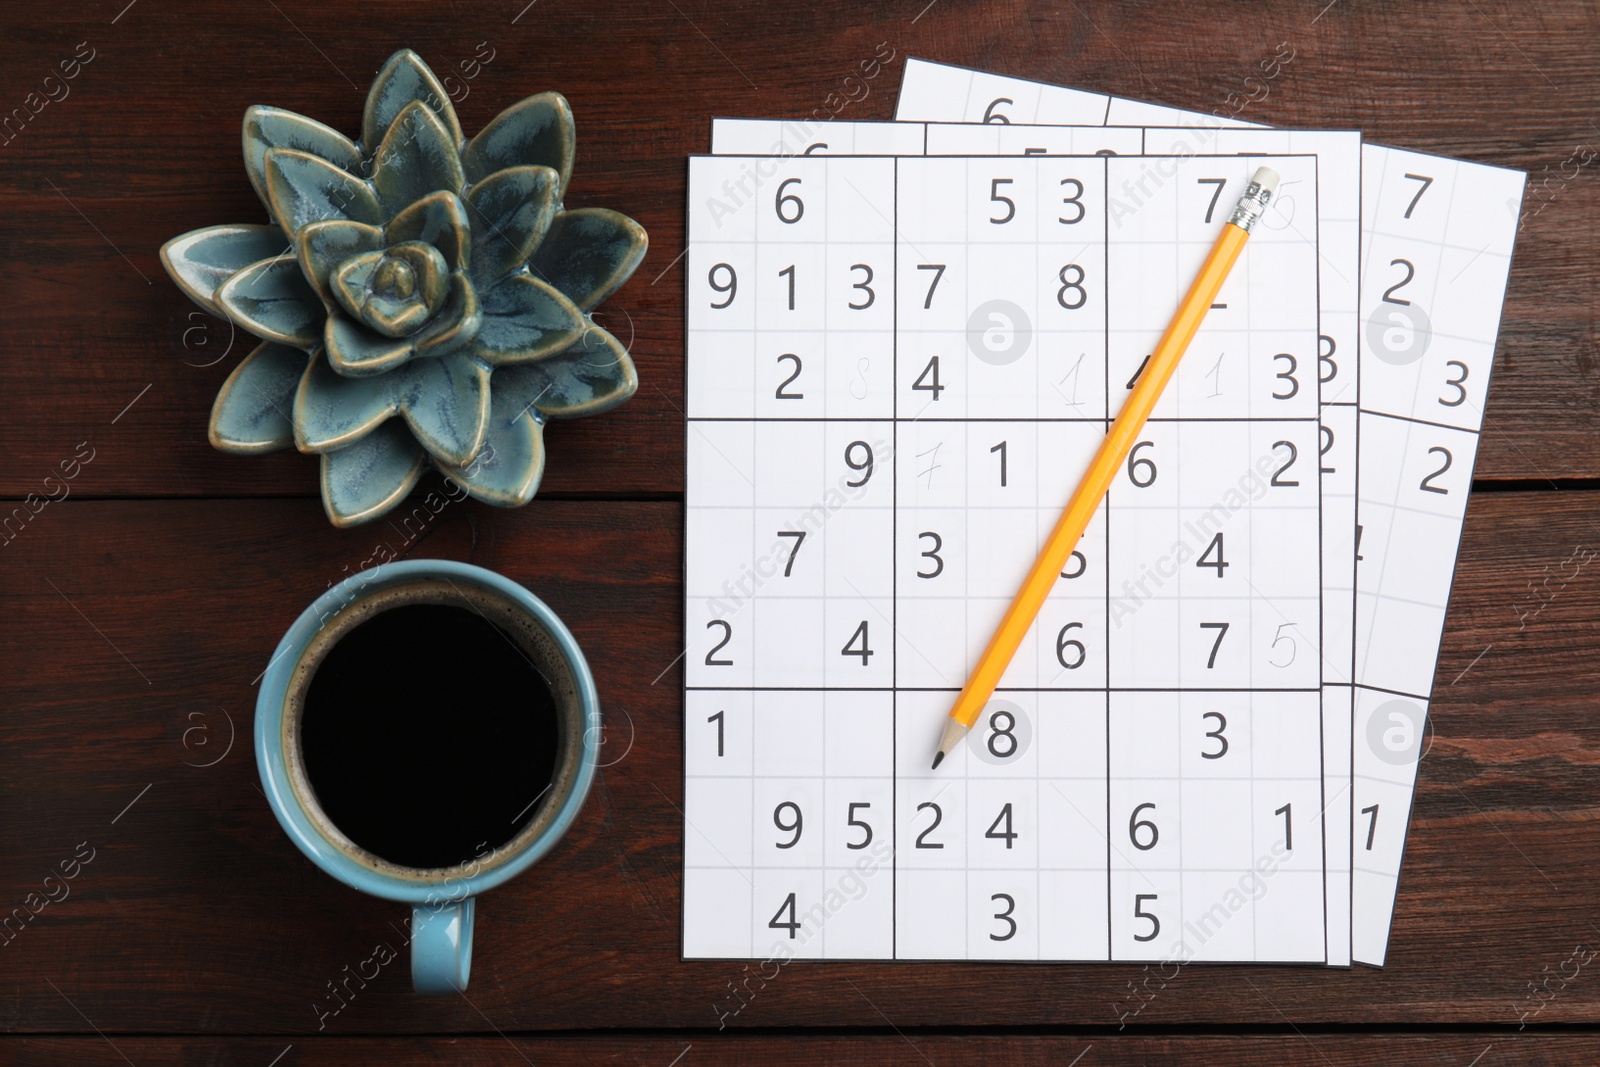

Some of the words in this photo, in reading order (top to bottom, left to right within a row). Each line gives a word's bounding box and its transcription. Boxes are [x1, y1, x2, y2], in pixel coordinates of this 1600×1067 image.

[775, 177, 805, 225] 6
[989, 178, 1016, 225] 5
[1058, 178, 1086, 225] 3
[1197, 178, 1227, 224] 7
[1404, 173, 1434, 219] 7
[708, 262, 738, 310] 9
[777, 264, 796, 311] 1
[848, 263, 876, 311] 3
[916, 264, 947, 310] 7
[1056, 264, 1088, 311] 8
[1381, 258, 1415, 307] 2
[775, 353, 804, 400] 2
[911, 355, 945, 402] 4
[1272, 353, 1299, 400] 3
[848, 356, 870, 401] 8
[1058, 352, 1086, 407] 1
[1204, 351, 1226, 400] 1
[1438, 360, 1469, 408] 3
[844, 440, 874, 488] 9
[989, 440, 1008, 488] 1
[1127, 440, 1157, 489] 6
[1270, 440, 1300, 487] 2
[914, 441, 944, 491] 7
[1419, 446, 1453, 495] 2
[776, 531, 807, 578] 7
[916, 531, 944, 580] 3
[1195, 532, 1230, 579] 4
[704, 619, 734, 666] 2
[841, 620, 874, 667] 4
[1056, 621, 1086, 670] 6
[1199, 622, 1230, 669] 7
[1268, 621, 1299, 669] 5
[706, 710, 726, 758] 1
[987, 710, 1018, 759] 8
[1201, 711, 1229, 760] 3
[773, 800, 803, 850] 9
[846, 802, 873, 850] 5
[915, 801, 945, 850] 2
[984, 802, 1019, 850] 4
[1128, 802, 1159, 851] 6
[1274, 802, 1294, 851] 1
[1361, 803, 1381, 851] 1
[768, 892, 802, 940] 4
[989, 893, 1017, 942] 3
[1133, 893, 1161, 943] 5
